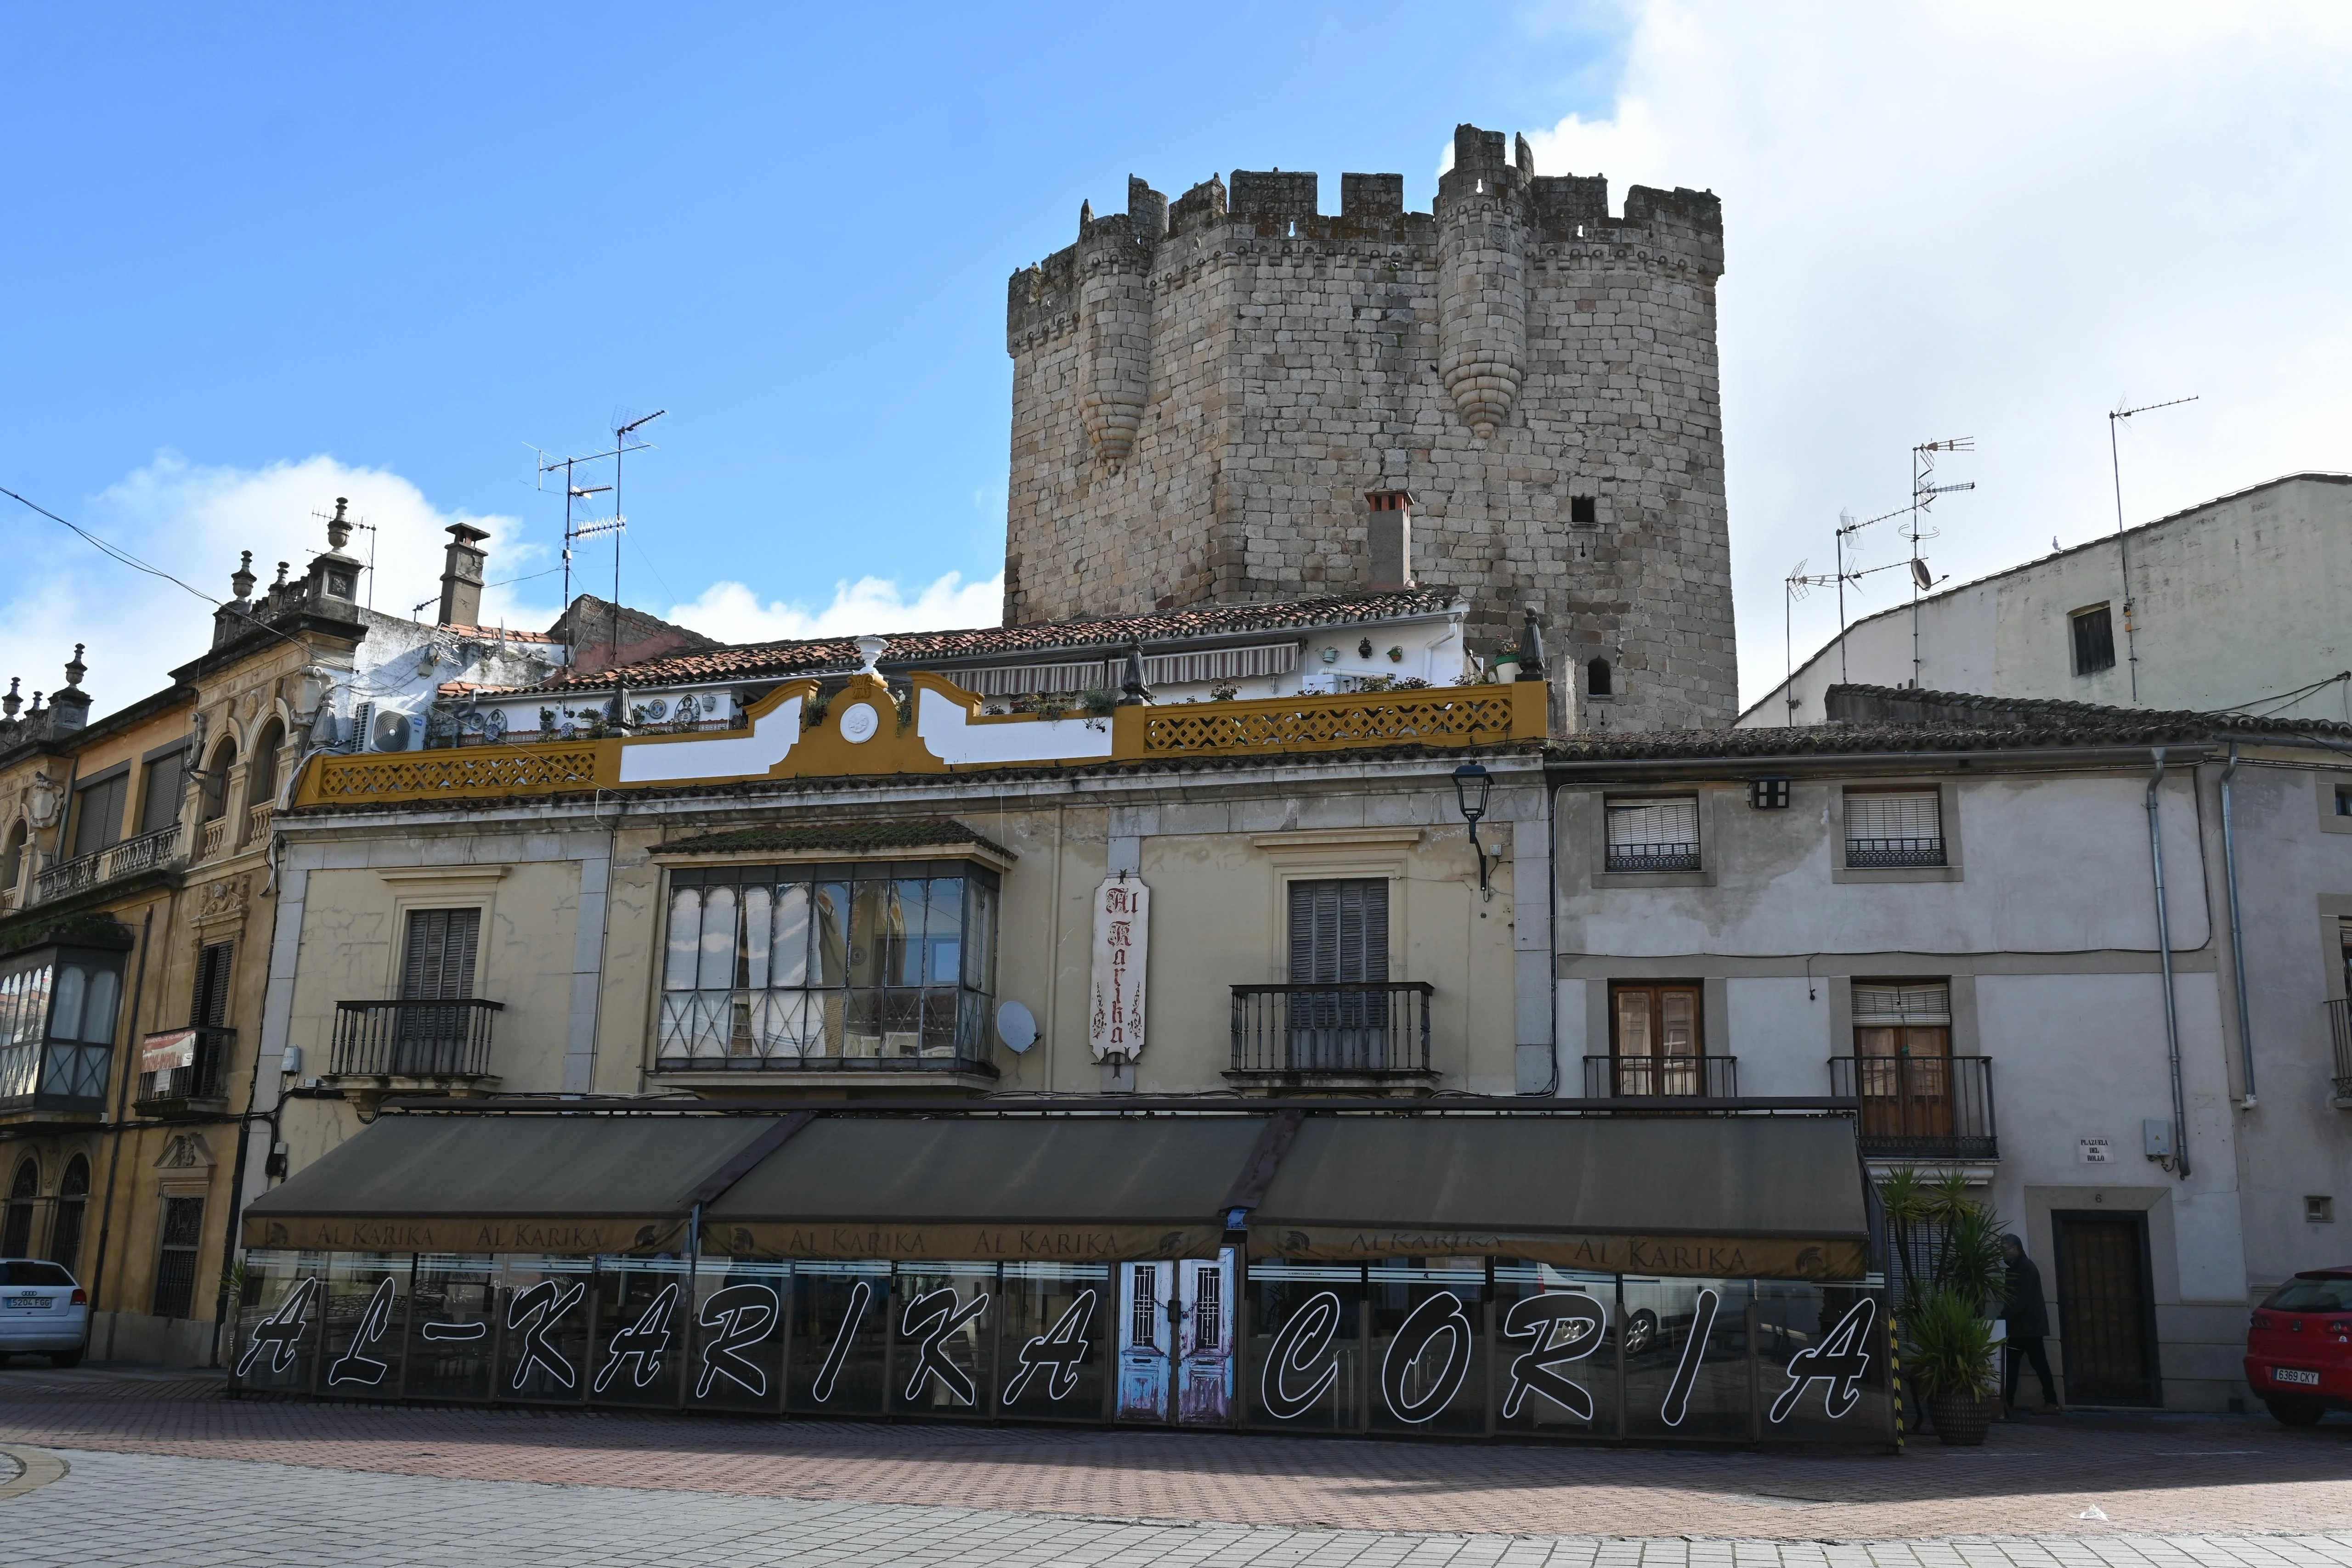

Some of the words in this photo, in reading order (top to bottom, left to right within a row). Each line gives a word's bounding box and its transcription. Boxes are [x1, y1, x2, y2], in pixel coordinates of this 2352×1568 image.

[2095, 1194, 2103, 1203] 6
[317, 1224, 342, 1245] AL
[353, 1224, 434, 1246] KARIKA
[476, 1224, 504, 1247] AL
[515, 1224, 602, 1248] KARIKA
[789, 1229, 818, 1251] AL
[832, 1229, 926, 1253] KARIKA
[972, 1230, 1006, 1254] AL
[1019, 1230, 1119, 1254] KARIKA
[1391, 1233, 1504, 1250] KARIKA
[1574, 1239, 1613, 1264] AL
[1628, 1241, 1748, 1270] KARIKA
[1261, 1289, 1876, 1427] CORIA
[2279, 1370, 2298, 1381] 6369
[2300, 1372, 2316, 1383] CKY
